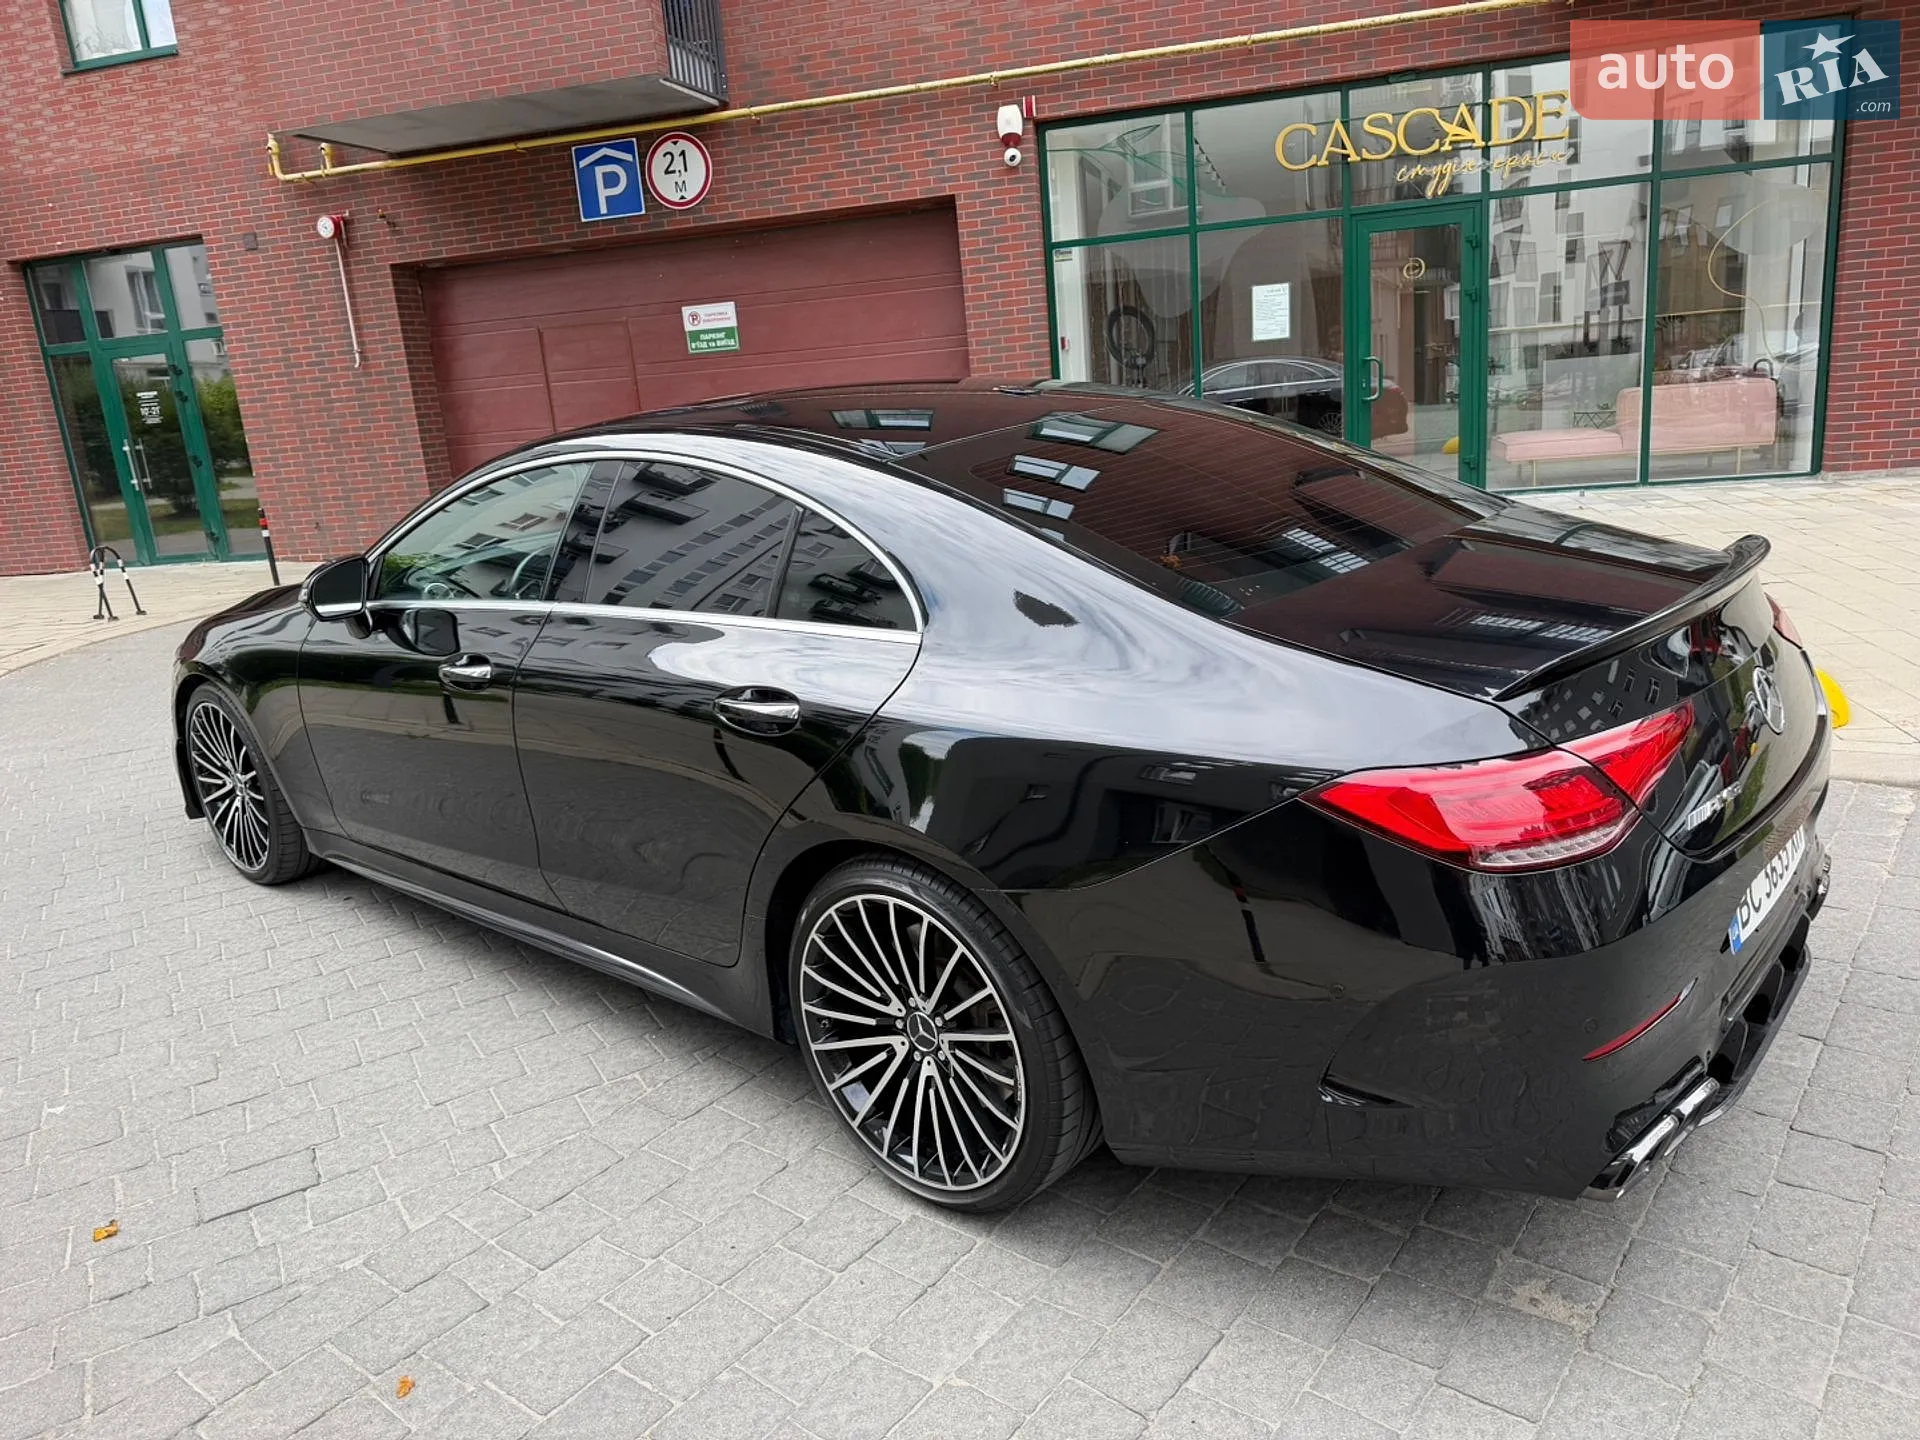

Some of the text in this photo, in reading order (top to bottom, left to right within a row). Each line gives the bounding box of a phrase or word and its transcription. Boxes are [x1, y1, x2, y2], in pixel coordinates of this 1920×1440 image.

[1274, 89, 1571, 172] CASCADE
[662, 149, 688, 177] 2,1
[594, 164, 628, 215] P
